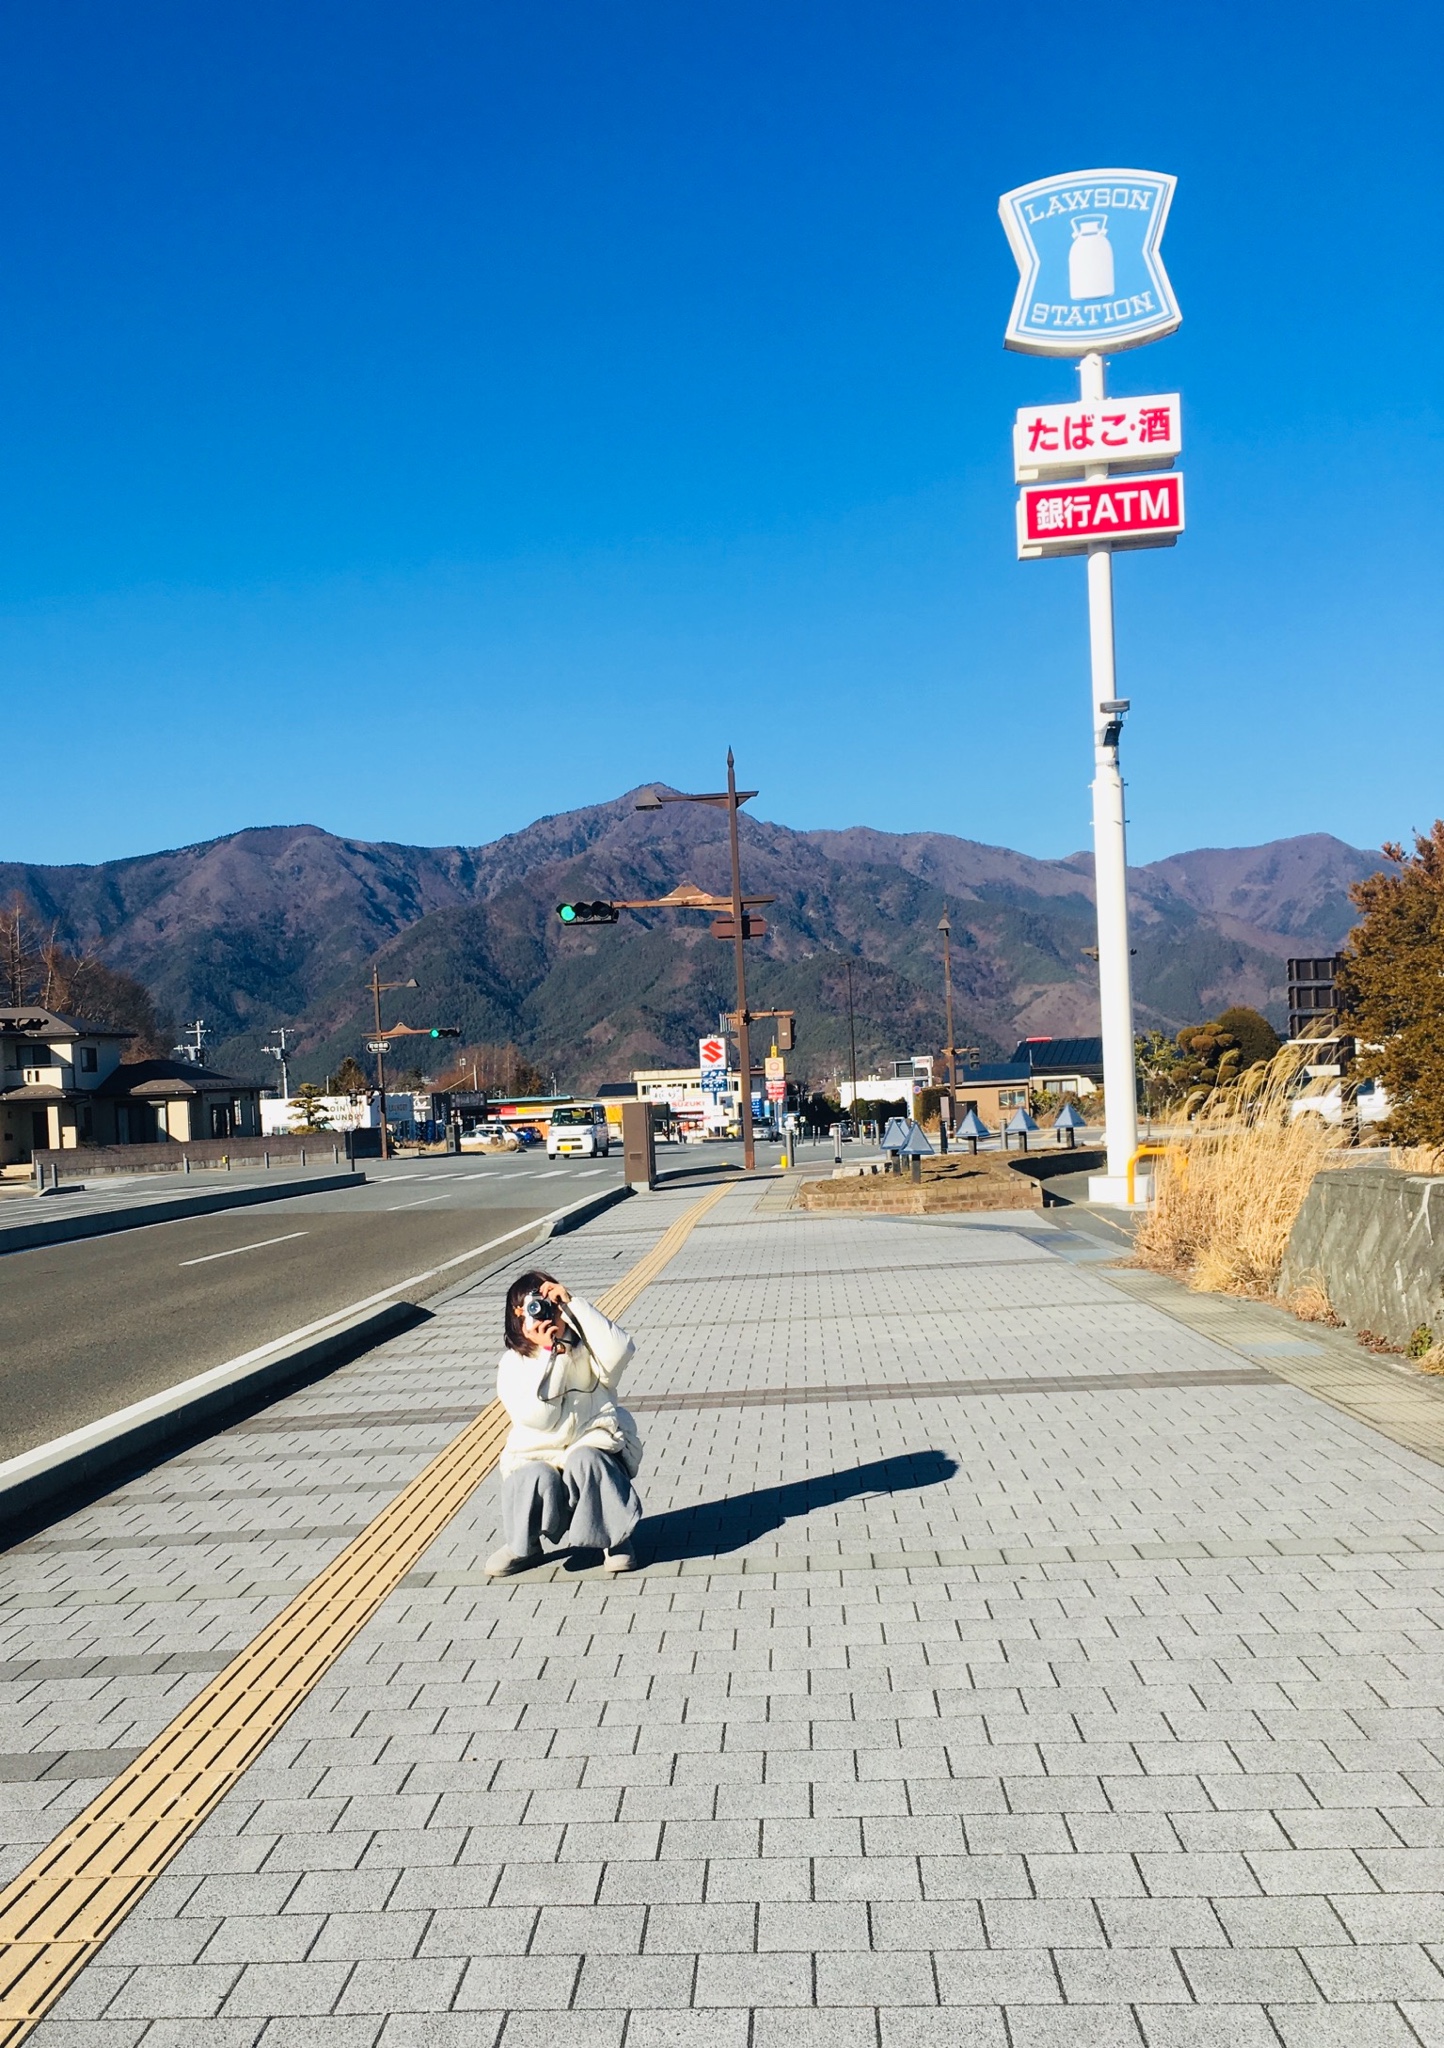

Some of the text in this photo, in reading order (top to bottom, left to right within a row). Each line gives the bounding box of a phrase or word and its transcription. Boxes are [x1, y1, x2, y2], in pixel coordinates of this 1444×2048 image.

[1024, 188, 1154, 224] LAWSON
[1031, 291, 1155, 326] STATION
[1036, 487, 1170, 531] 銀行ATM
[327, 1113, 364, 1121] AUNDRY
